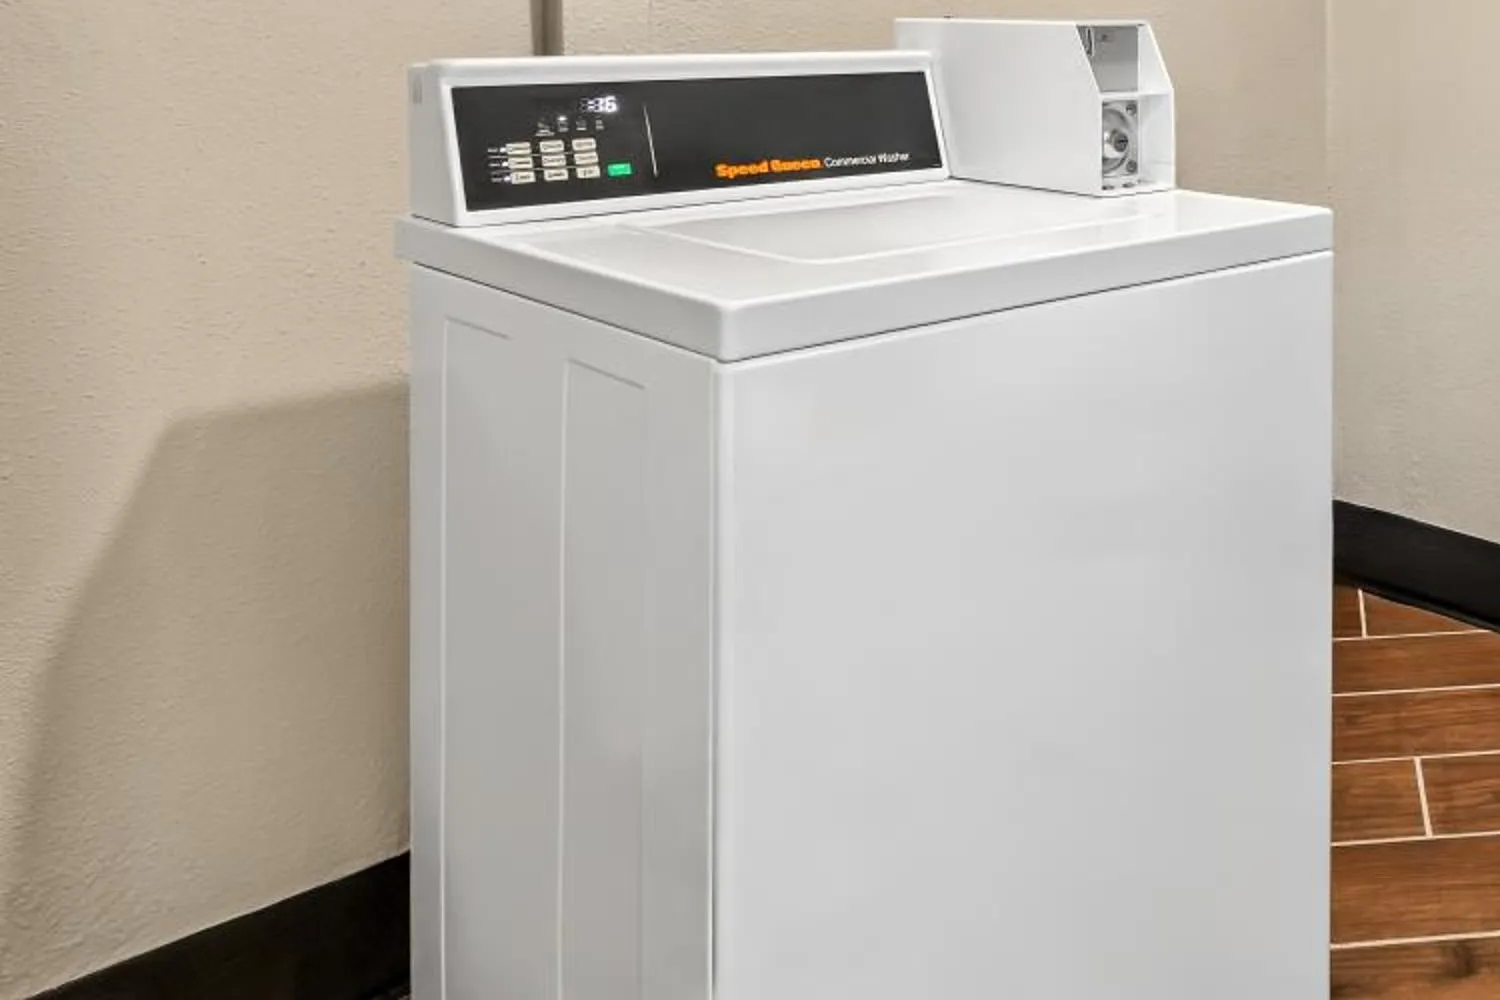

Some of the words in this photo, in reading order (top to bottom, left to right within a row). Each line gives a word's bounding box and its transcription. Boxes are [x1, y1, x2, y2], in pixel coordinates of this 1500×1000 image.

[715, 160, 769, 178] Speed
[824, 156, 877, 168] Commercial
[878, 152, 910, 164] Washer
